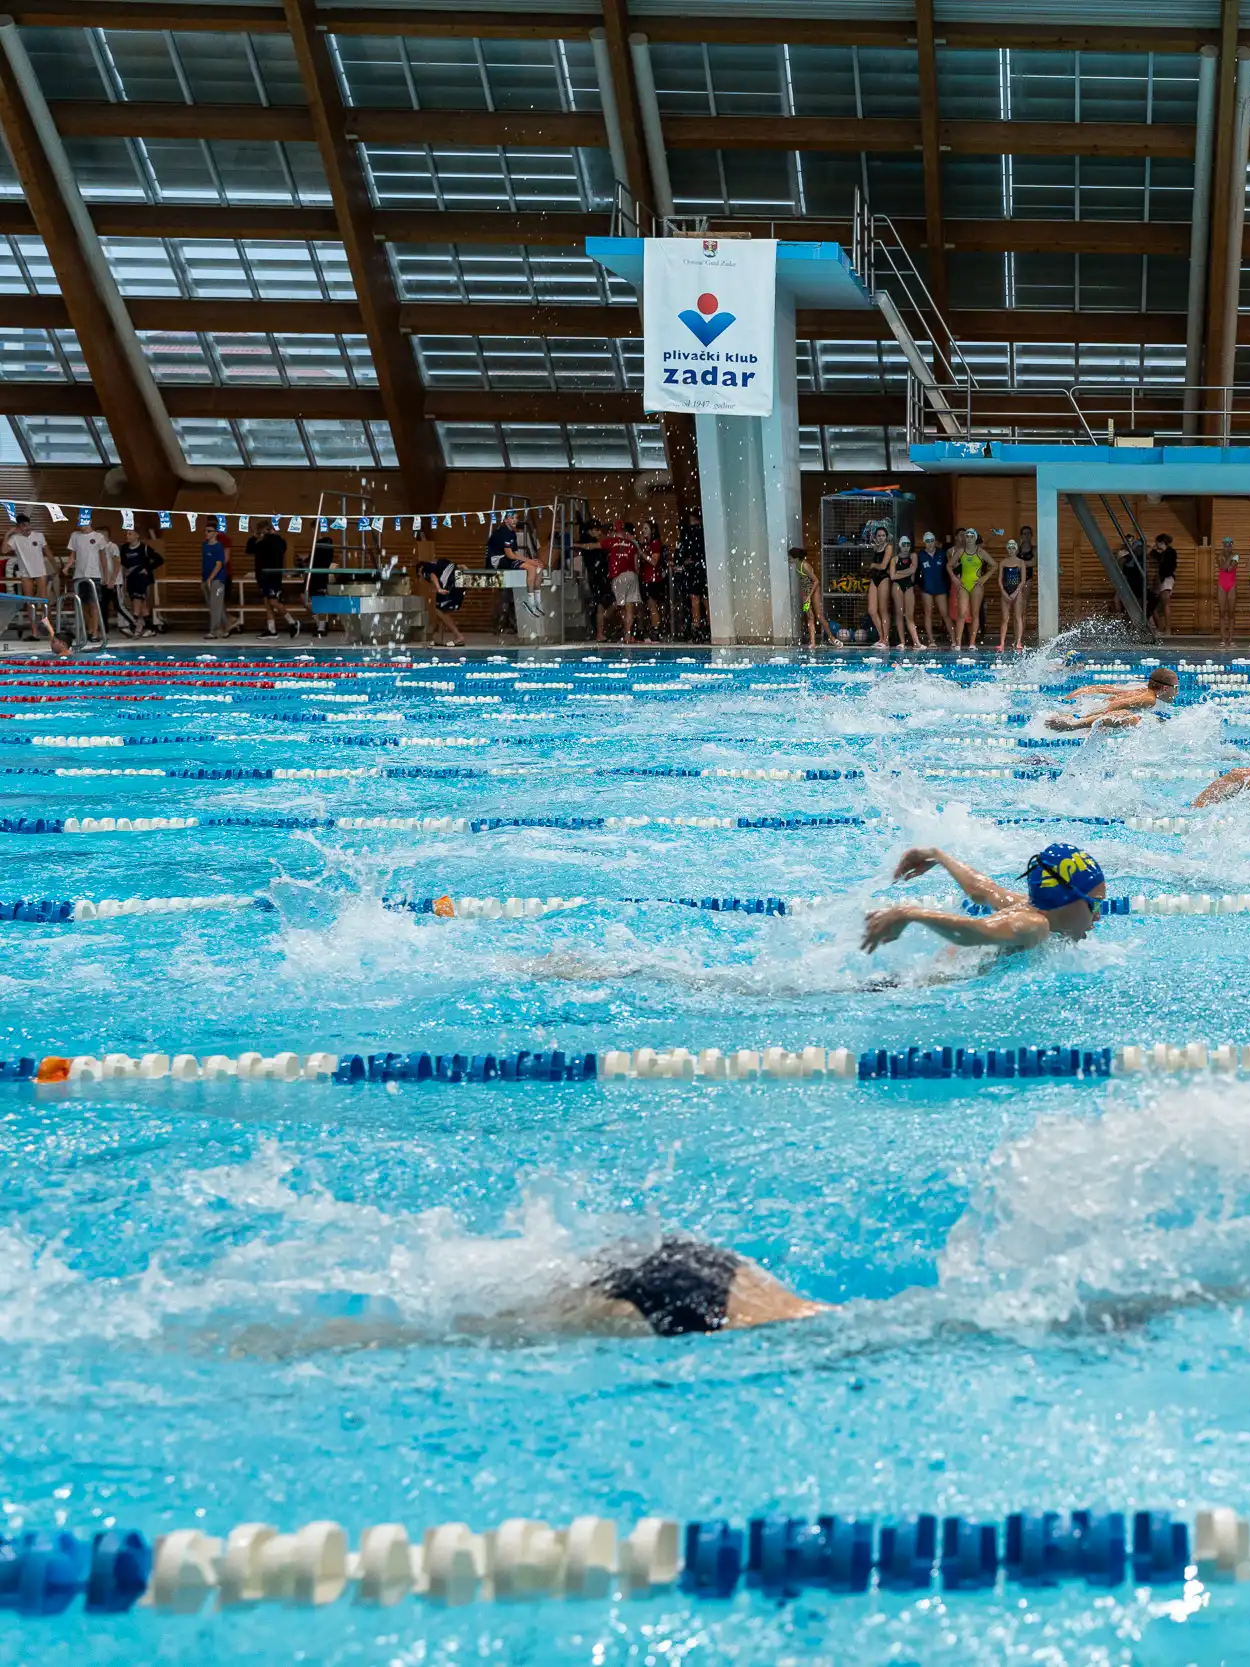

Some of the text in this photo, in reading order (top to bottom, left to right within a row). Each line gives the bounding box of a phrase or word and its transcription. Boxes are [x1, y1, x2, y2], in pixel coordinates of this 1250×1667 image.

[663, 350, 758, 364] plivački klub
[663, 366, 756, 388] zadar
